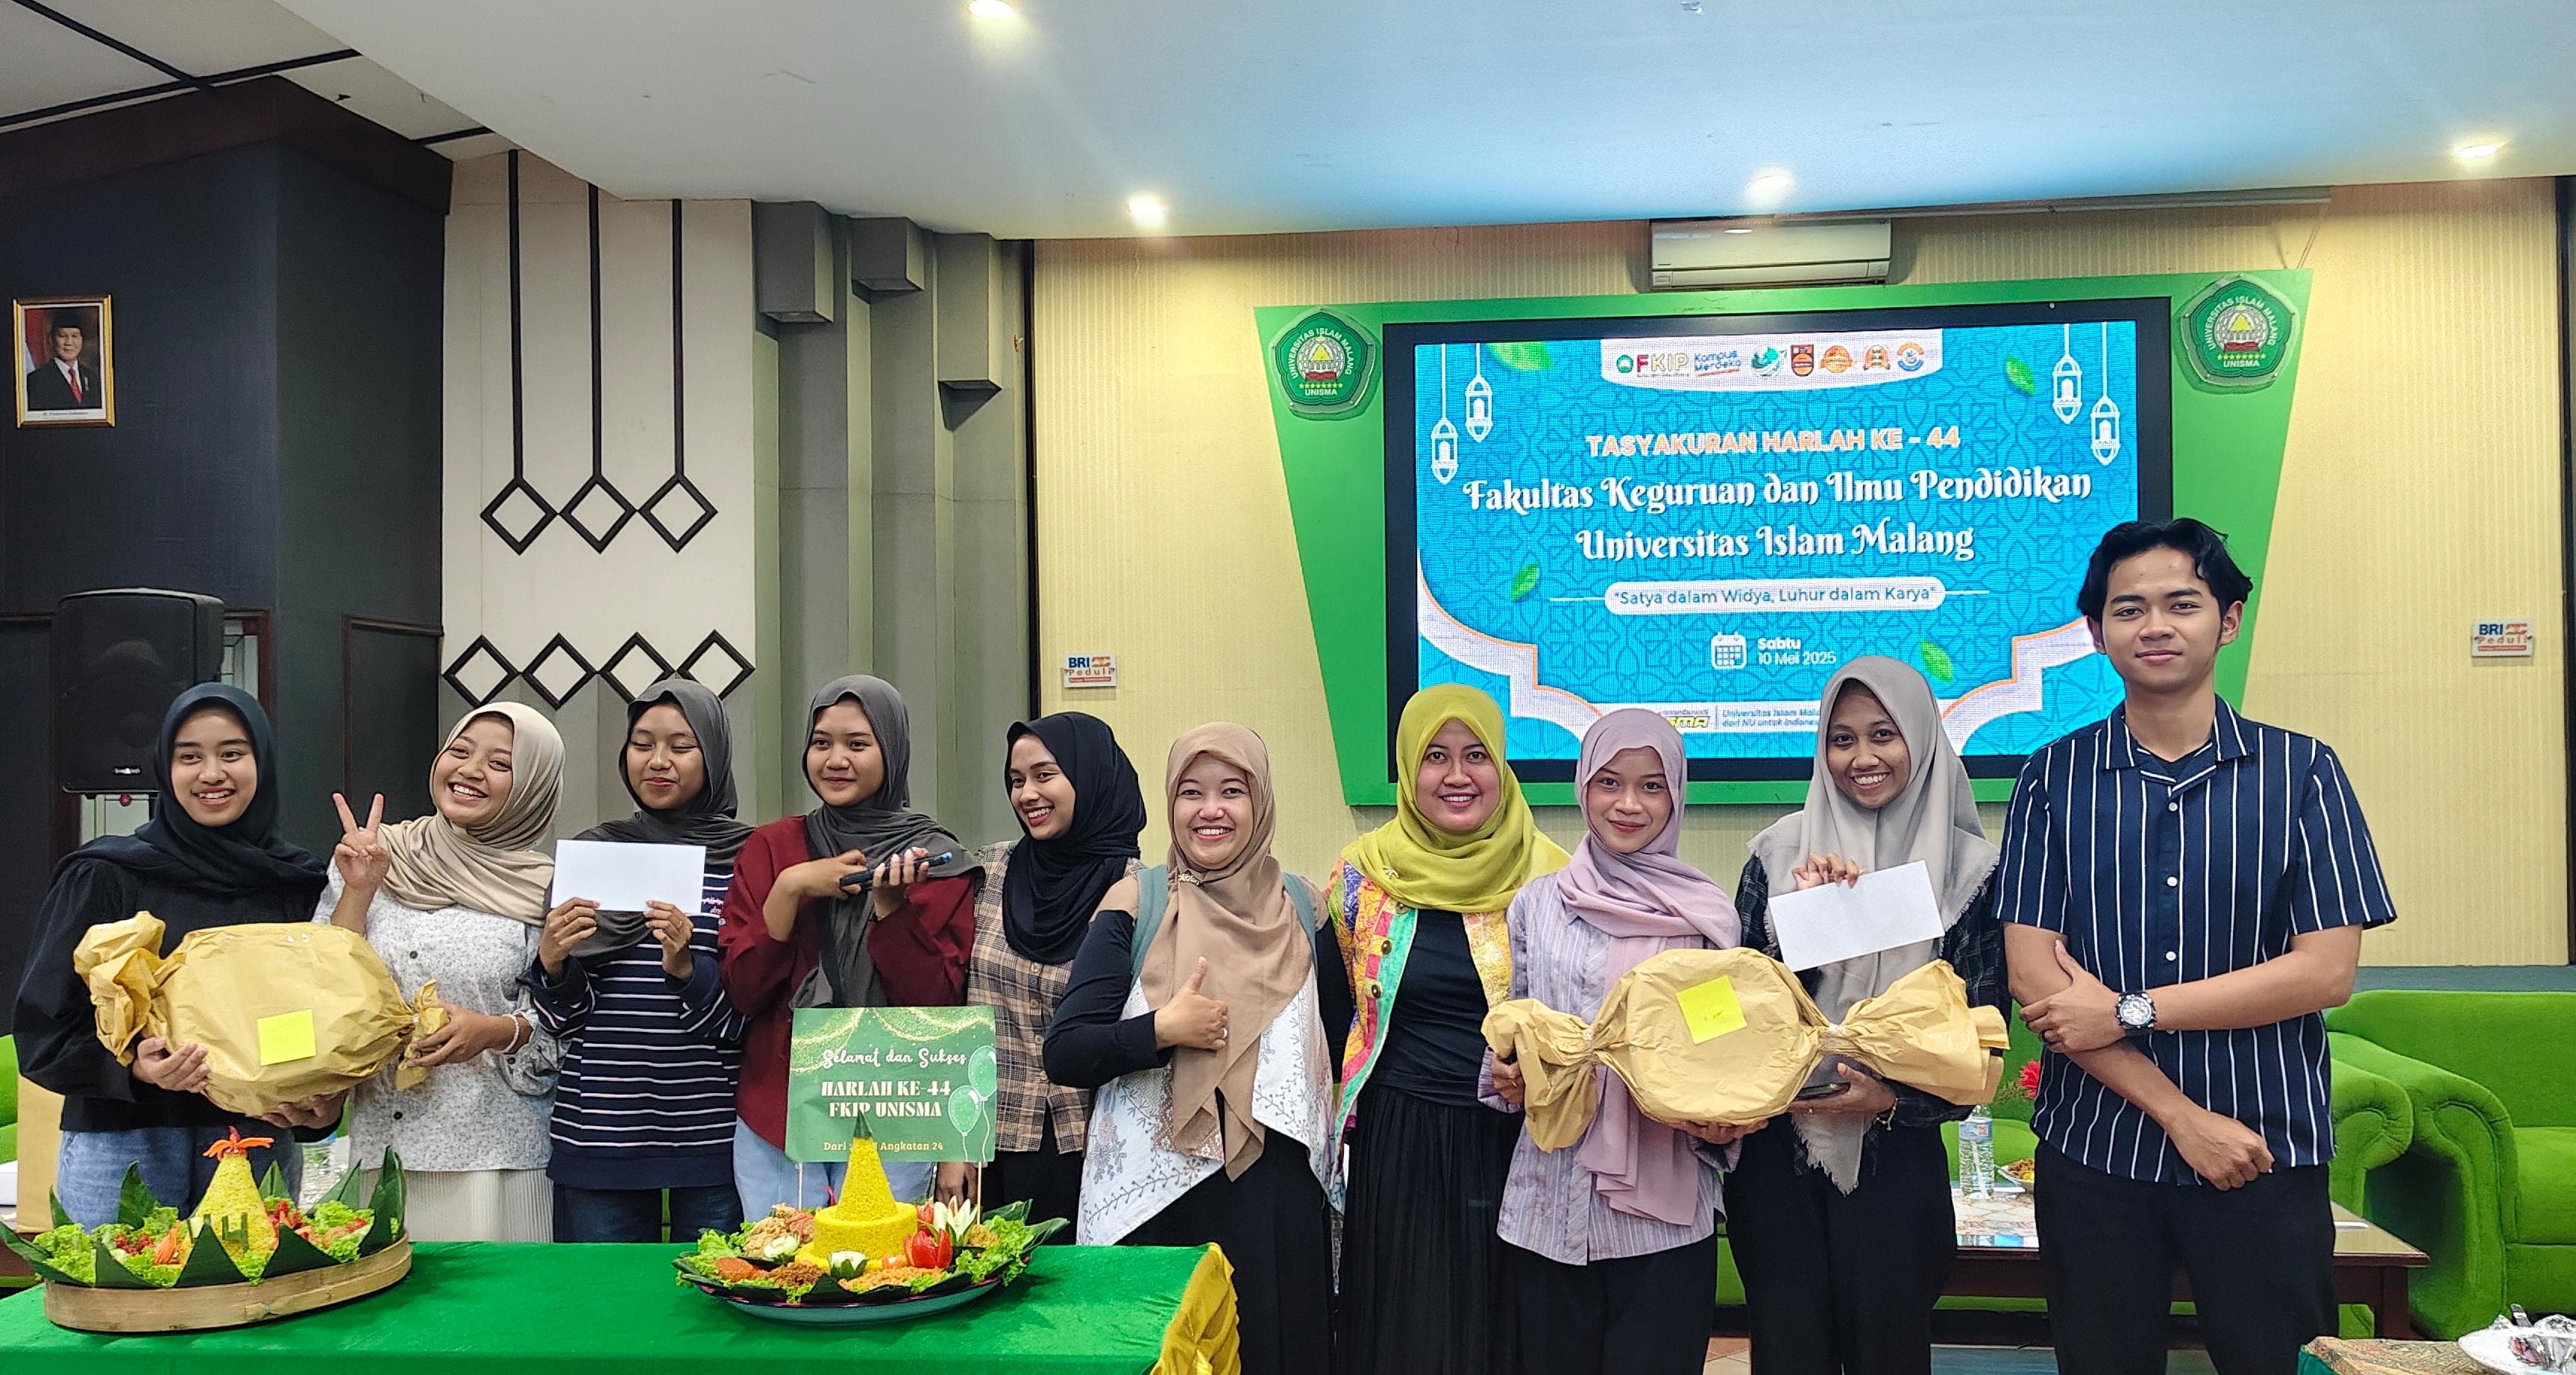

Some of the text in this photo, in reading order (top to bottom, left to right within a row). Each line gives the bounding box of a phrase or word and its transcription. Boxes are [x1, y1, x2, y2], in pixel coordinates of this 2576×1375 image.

[2204, 295, 2278, 350] UNIVERSITAS ISLAM MALANG
[1288, 327, 1354, 380] UNIVERSITAS ISLAM MALANG
[1636, 352, 1689, 373] FKIP
[1586, 433, 1756, 458] TASYAKURAN
[1762, 429, 1865, 453] HARLAH
[1870, 427, 1904, 449] KE
[1926, 426, 1961, 447] 44
[1463, 466, 2092, 516] Fakultas Keguruan dan Ilmu Pendidikan
[1575, 516, 1976, 561] Universitas Islam Malang
[1667, 591, 1718, 604] dalam
[1721, 588, 1775, 605] Widya,
[1779, 588, 1826, 602] Luhur
[1829, 587, 1880, 601] dalam
[2479, 623, 2504, 635] BRI
[1757, 637, 1802, 650] Sabtu
[2478, 635, 2527, 644] Peduli
[1068, 657, 1090, 668] BRI
[1758, 650, 1837, 665] 10 Mei 2025
[1069, 667, 1111, 676] Peduli
[821, 1048, 967, 1069] Selamat dan Sukses
[821, 1080, 893, 1097] HARLAH
[829, 1101, 943, 1117] FKIP UNISMA
[823, 1142, 846, 1151] Dari
[880, 1142, 929, 1152] Angkatan
[932, 1142, 943, 1151] 24
